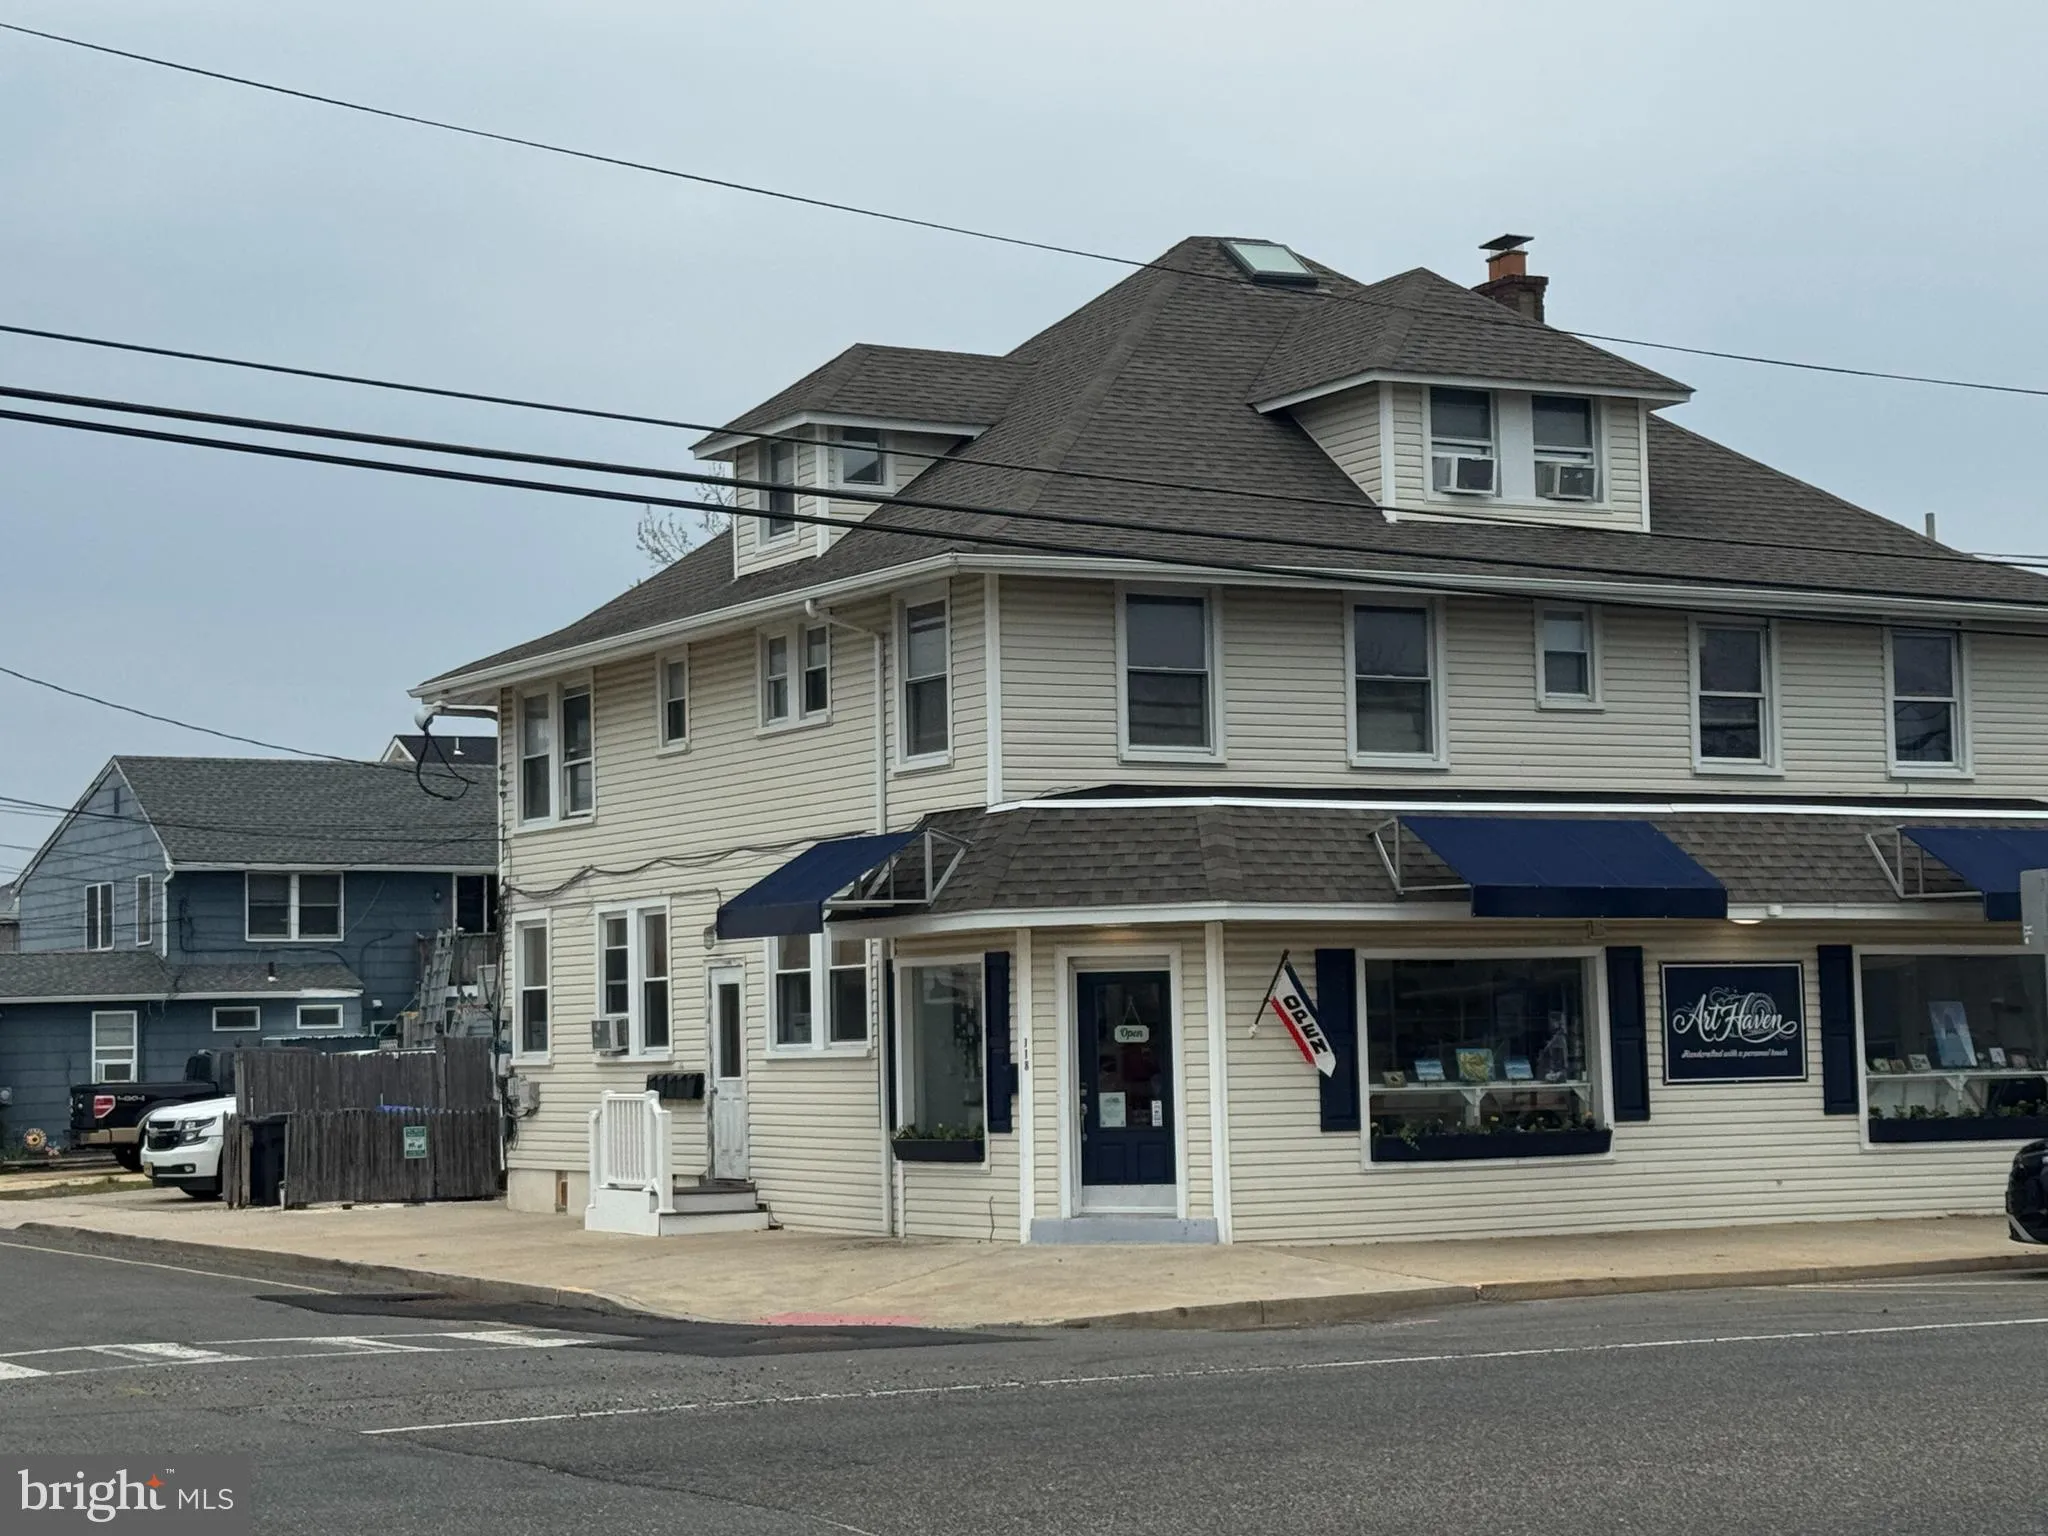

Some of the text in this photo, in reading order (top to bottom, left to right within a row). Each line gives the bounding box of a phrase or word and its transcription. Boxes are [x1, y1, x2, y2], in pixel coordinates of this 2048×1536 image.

[1120, 1027, 1143, 1040] Open
[1283, 994, 1328, 1055] OPEN
[1673, 992, 1798, 1043] Art Haven
